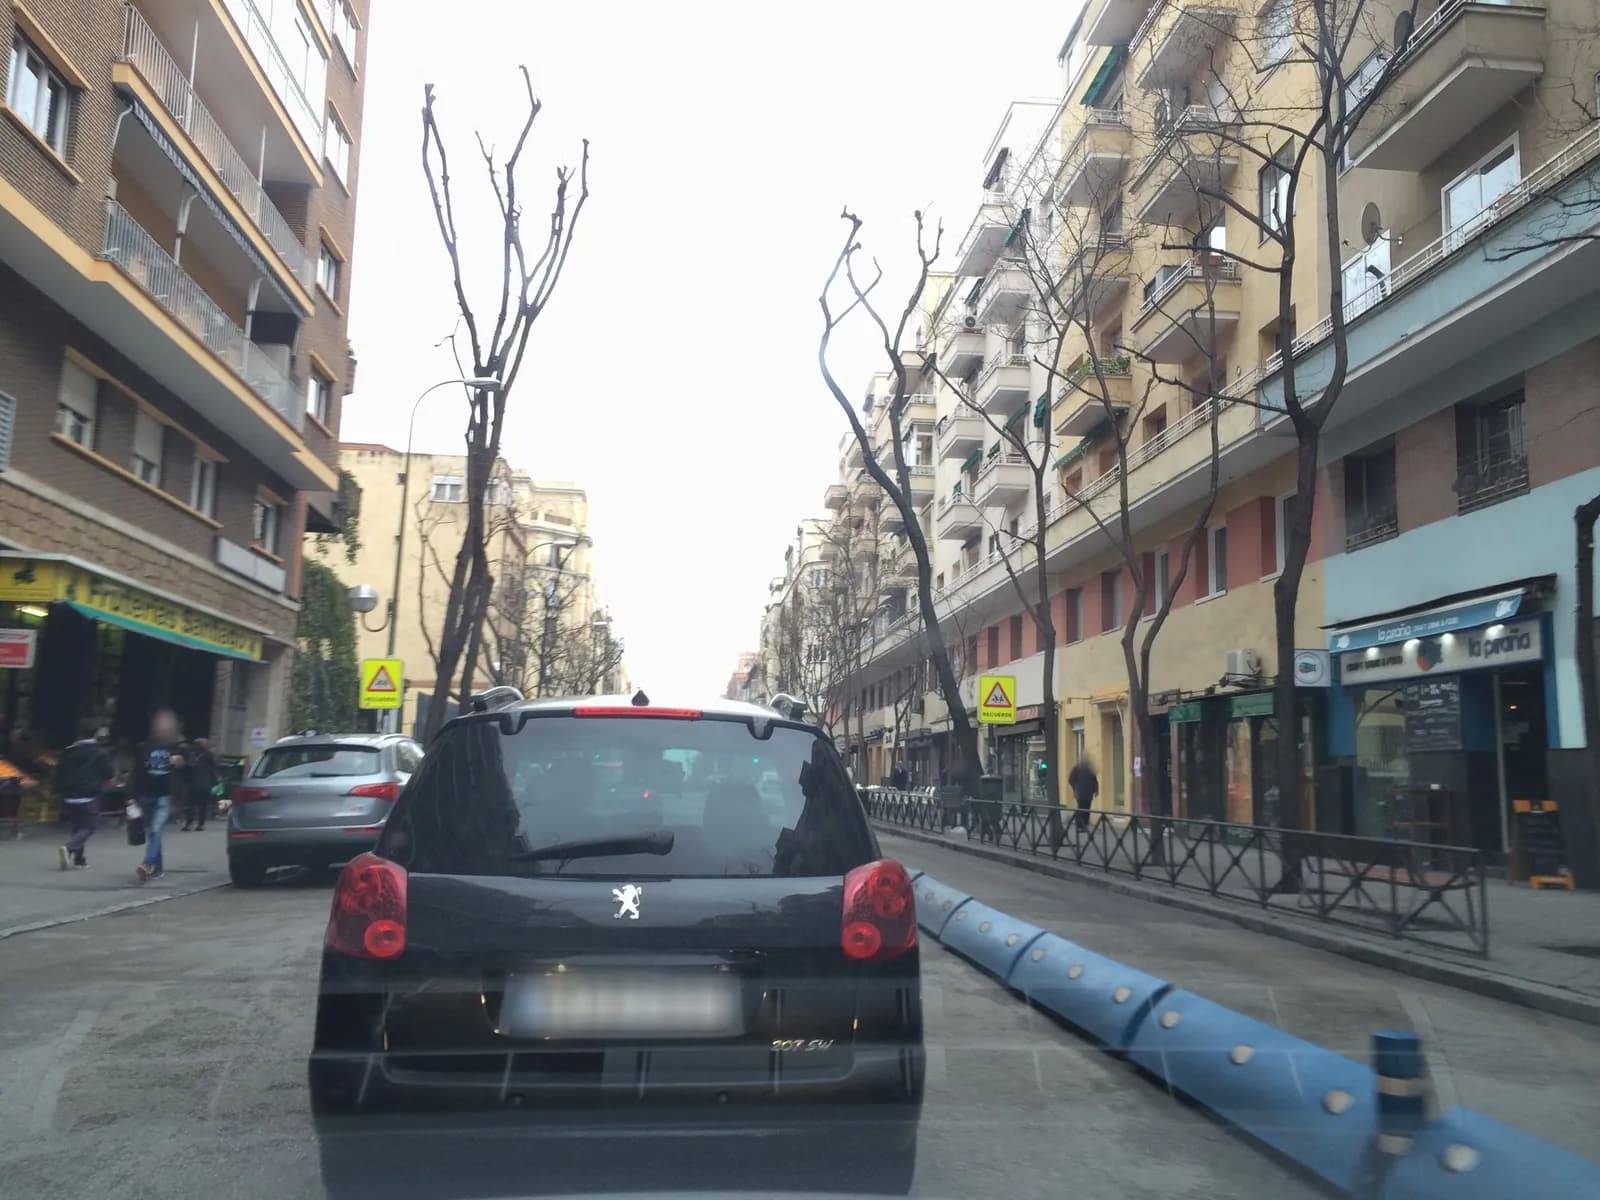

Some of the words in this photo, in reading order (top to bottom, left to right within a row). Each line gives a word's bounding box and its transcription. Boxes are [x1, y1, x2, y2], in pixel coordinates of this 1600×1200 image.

[1468, 637, 1482, 658] la
[1484, 627, 1531, 660] piraña
[770, 1039, 804, 1051] 207
[804, 1039, 834, 1051] SW
